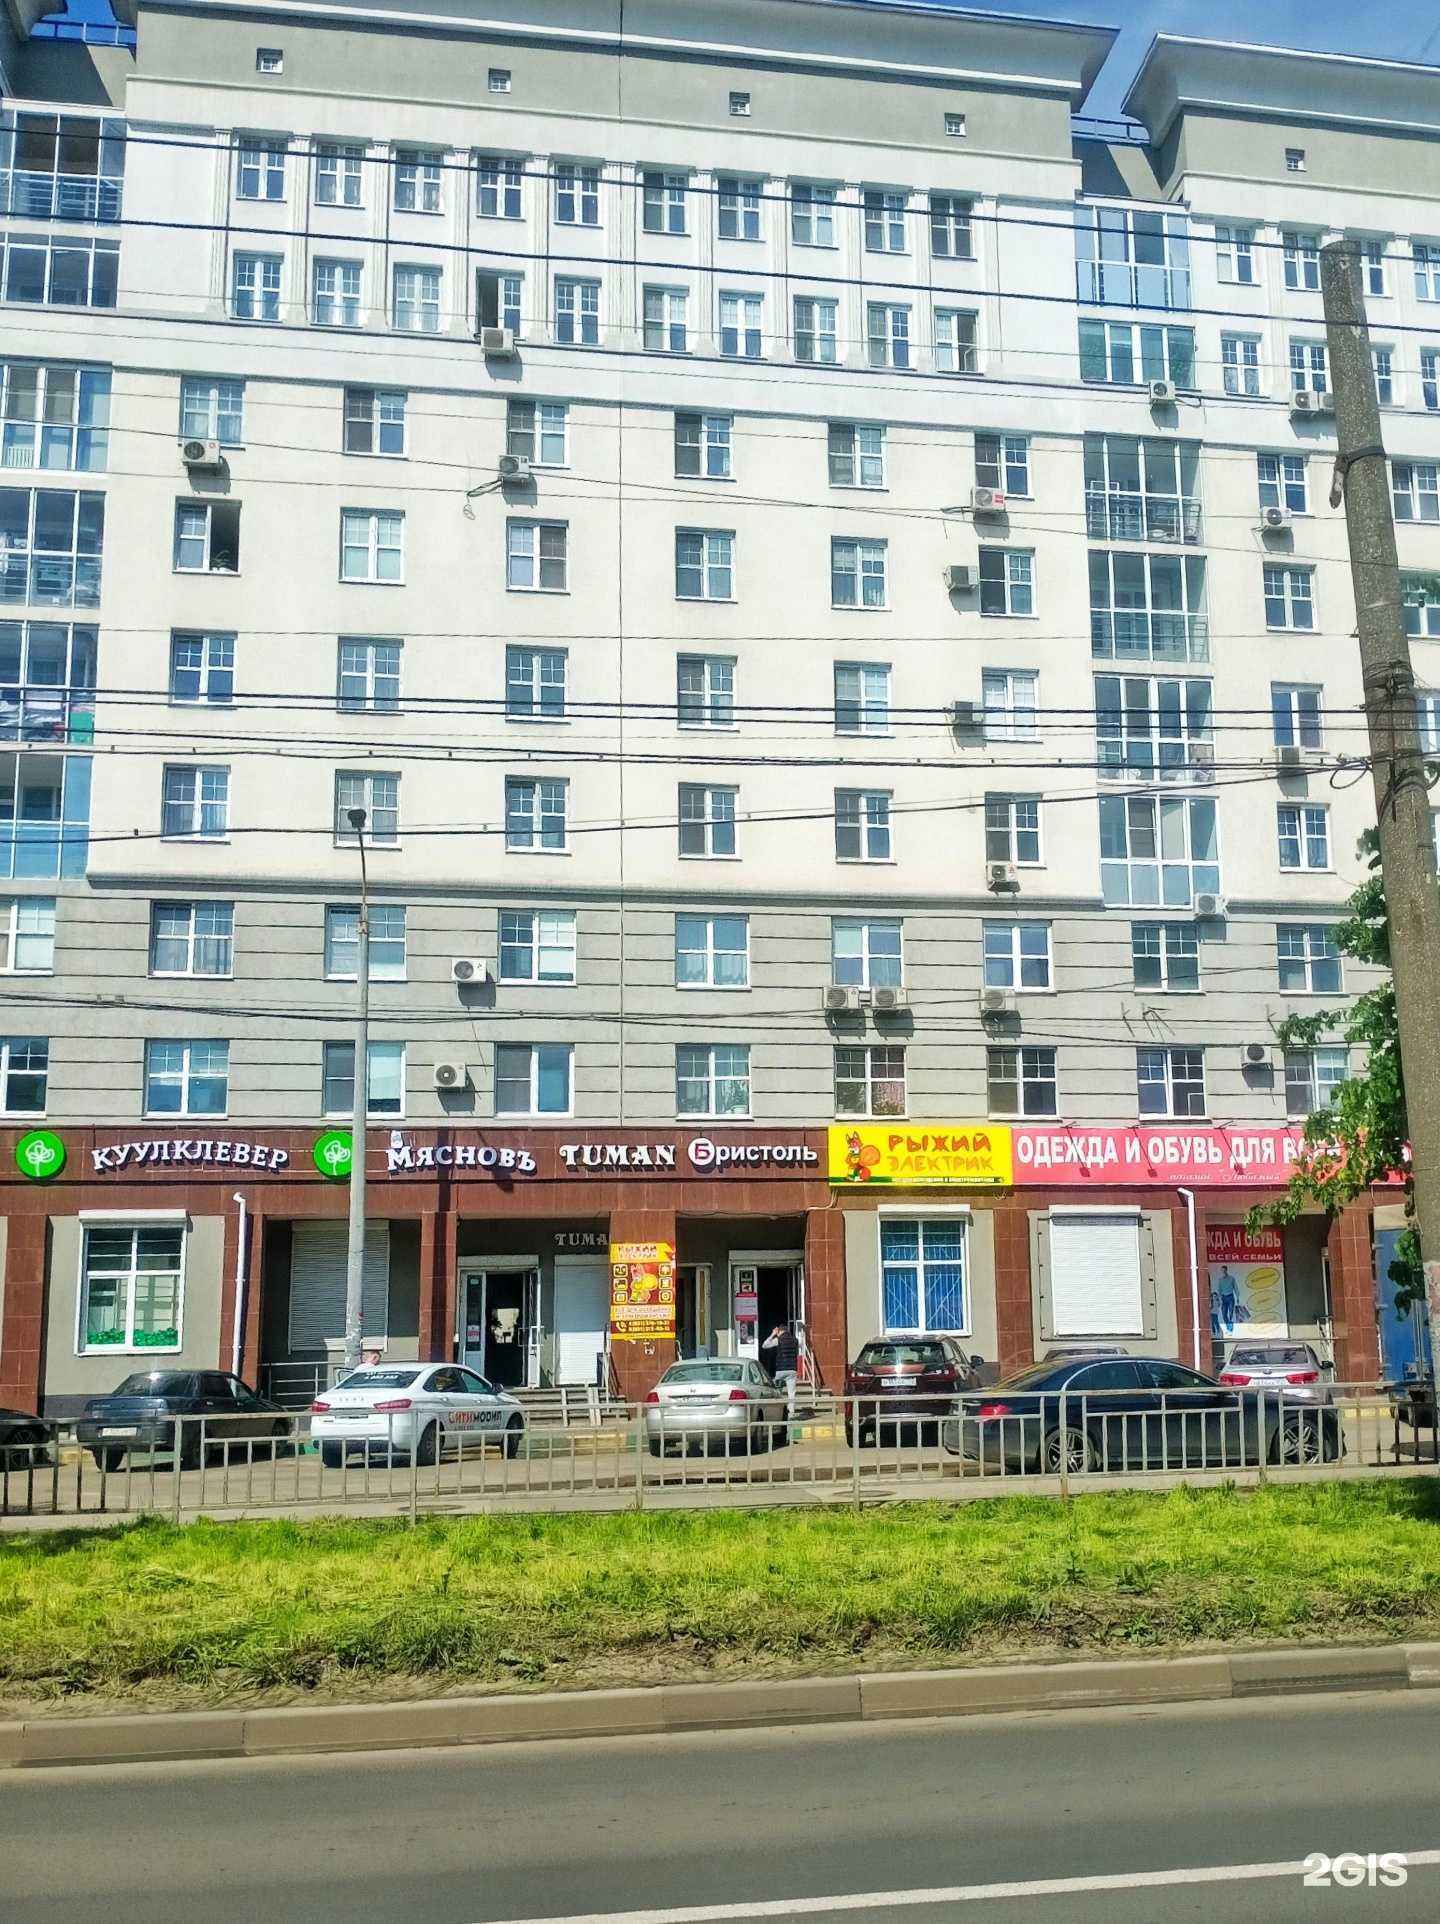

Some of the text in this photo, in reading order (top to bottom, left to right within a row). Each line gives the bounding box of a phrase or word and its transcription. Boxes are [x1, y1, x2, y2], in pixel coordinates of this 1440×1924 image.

[91, 1140, 288, 1170] КУУЛКЛЕВЕР
[559, 1144, 676, 1166] TUMAN
[688, 1137, 818, 1166] Бристоль
[888, 1133, 992, 1152] РЫЖИЙ
[1017, 1135, 1119, 1168] ОДЕЖДА
[1125, 1135, 1141, 1164] И
[1148, 1136, 1223, 1164] ОБУВЬ
[1230, 1136, 1276, 1168] ДЛЯ
[886, 1155, 994, 1172] ЭЛЕКТРИК
